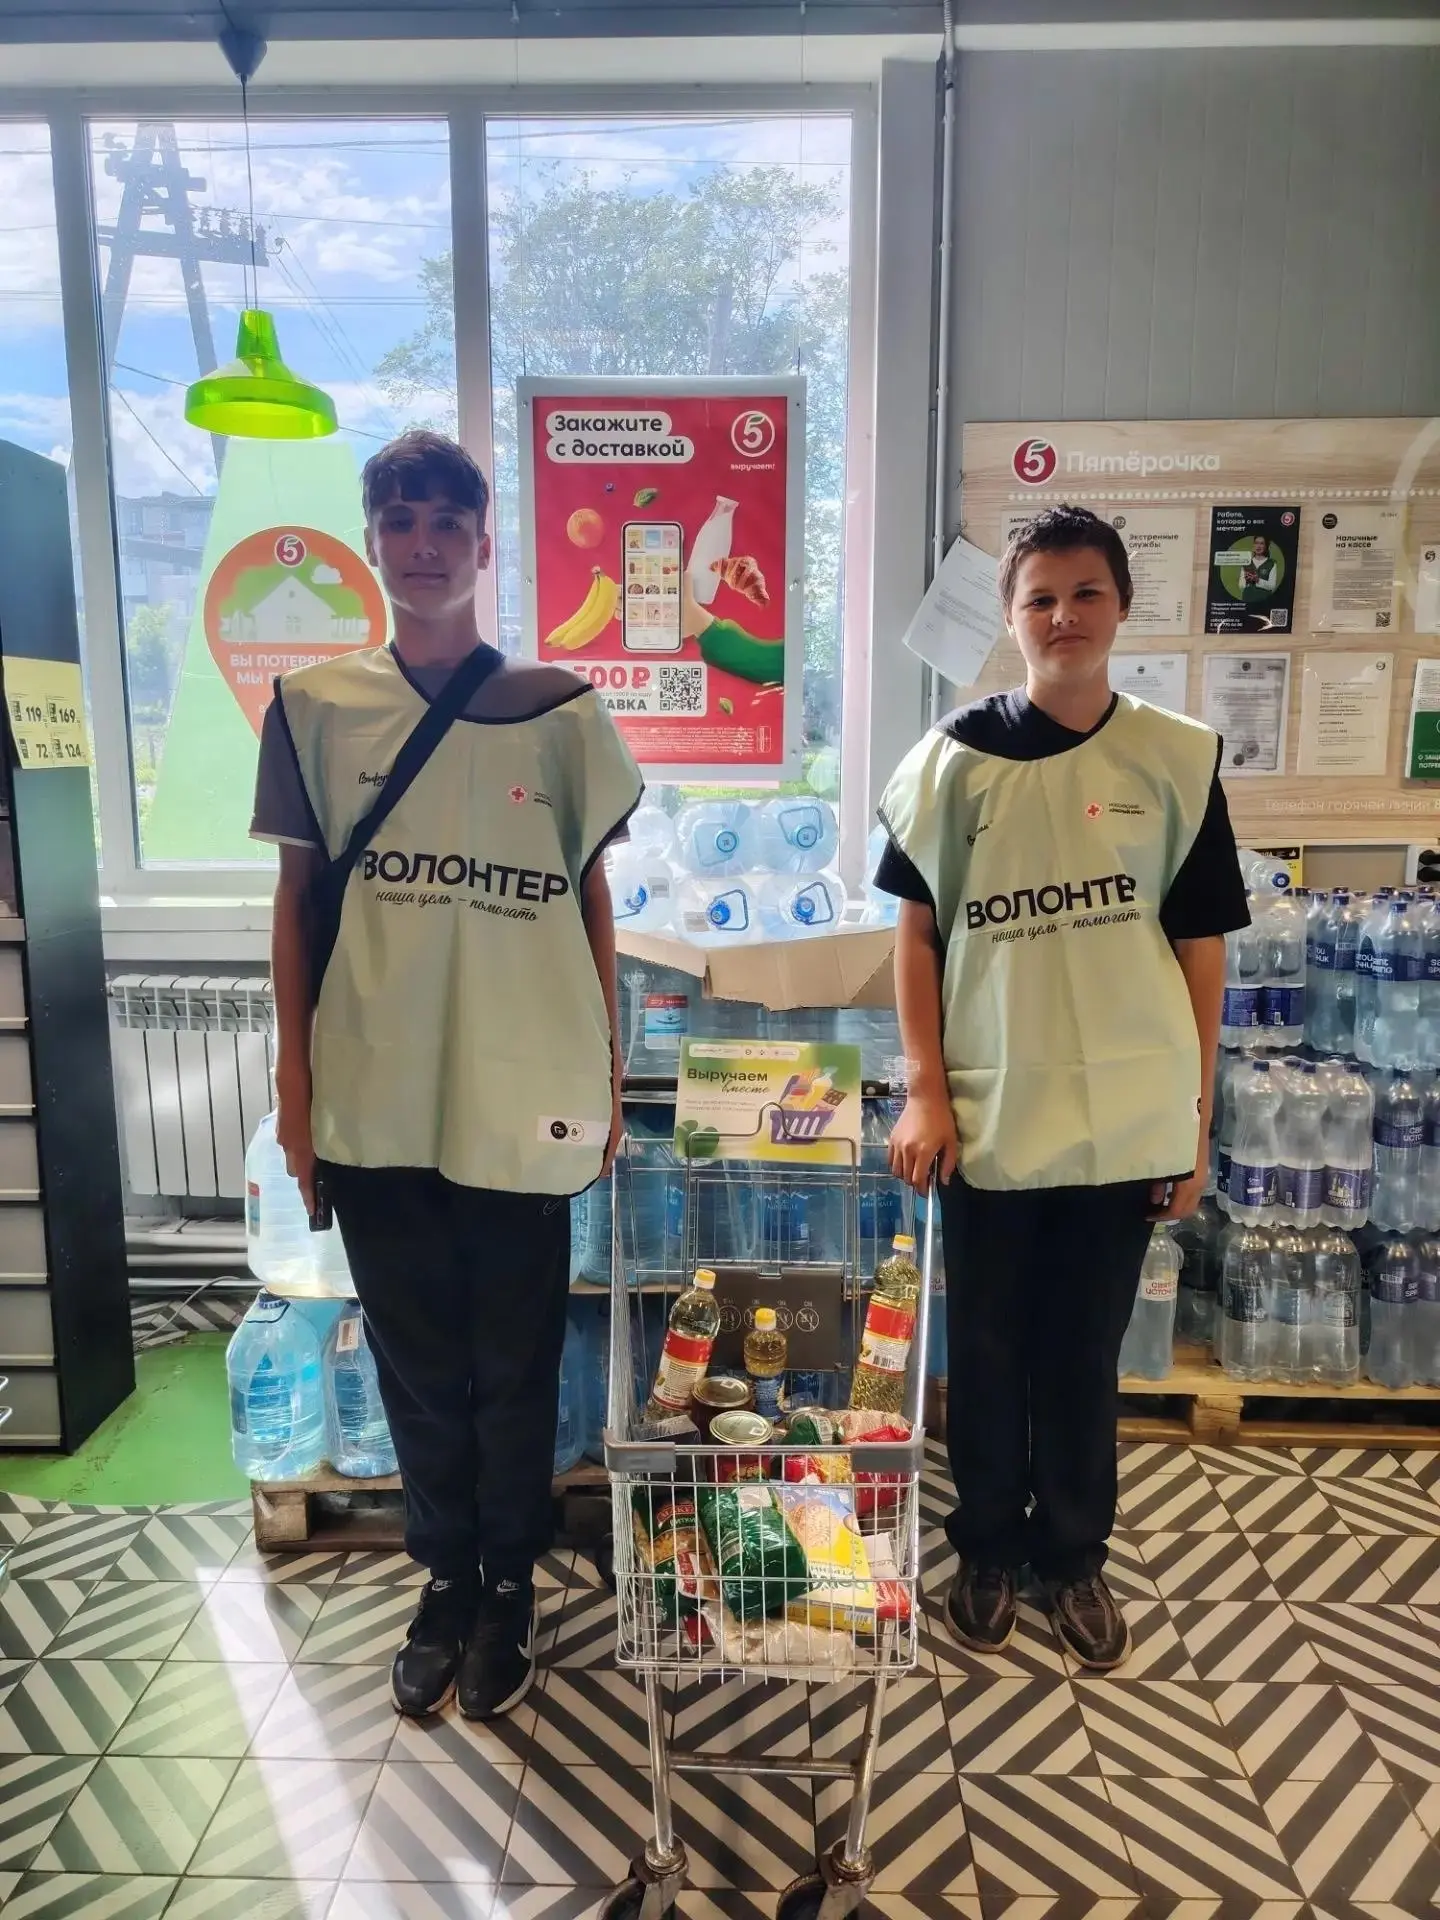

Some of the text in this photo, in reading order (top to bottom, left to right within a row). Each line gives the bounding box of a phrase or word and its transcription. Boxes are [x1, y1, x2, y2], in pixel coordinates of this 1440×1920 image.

[555, 414, 663, 432] Закажите
[742, 414, 767, 449] 5
[555, 439, 685, 457] с доставкой
[1023, 440, 1051, 477] 5
[1066, 450, 1220, 477] Пятёрочка
[1128, 534, 1179, 542] Экстренные
[1128, 541, 1161, 549] службы
[230, 654, 252, 667] ВЫ
[236, 671, 264, 685] МЫ
[25, 705, 42, 722] 119
[58, 708, 76, 723] 169
[36, 743, 49, 758] 72
[363, 849, 569, 903] ВОЛОНТЕР
[375, 889, 415, 906] наша
[417, 891, 453, 908] цель
[470, 898, 539, 922] помогать
[991, 929, 1025, 944] наша
[1027, 922, 1058, 941] цель
[687, 1068, 768, 1083] Выручаем
[721, 1079, 771, 1095] вместе
